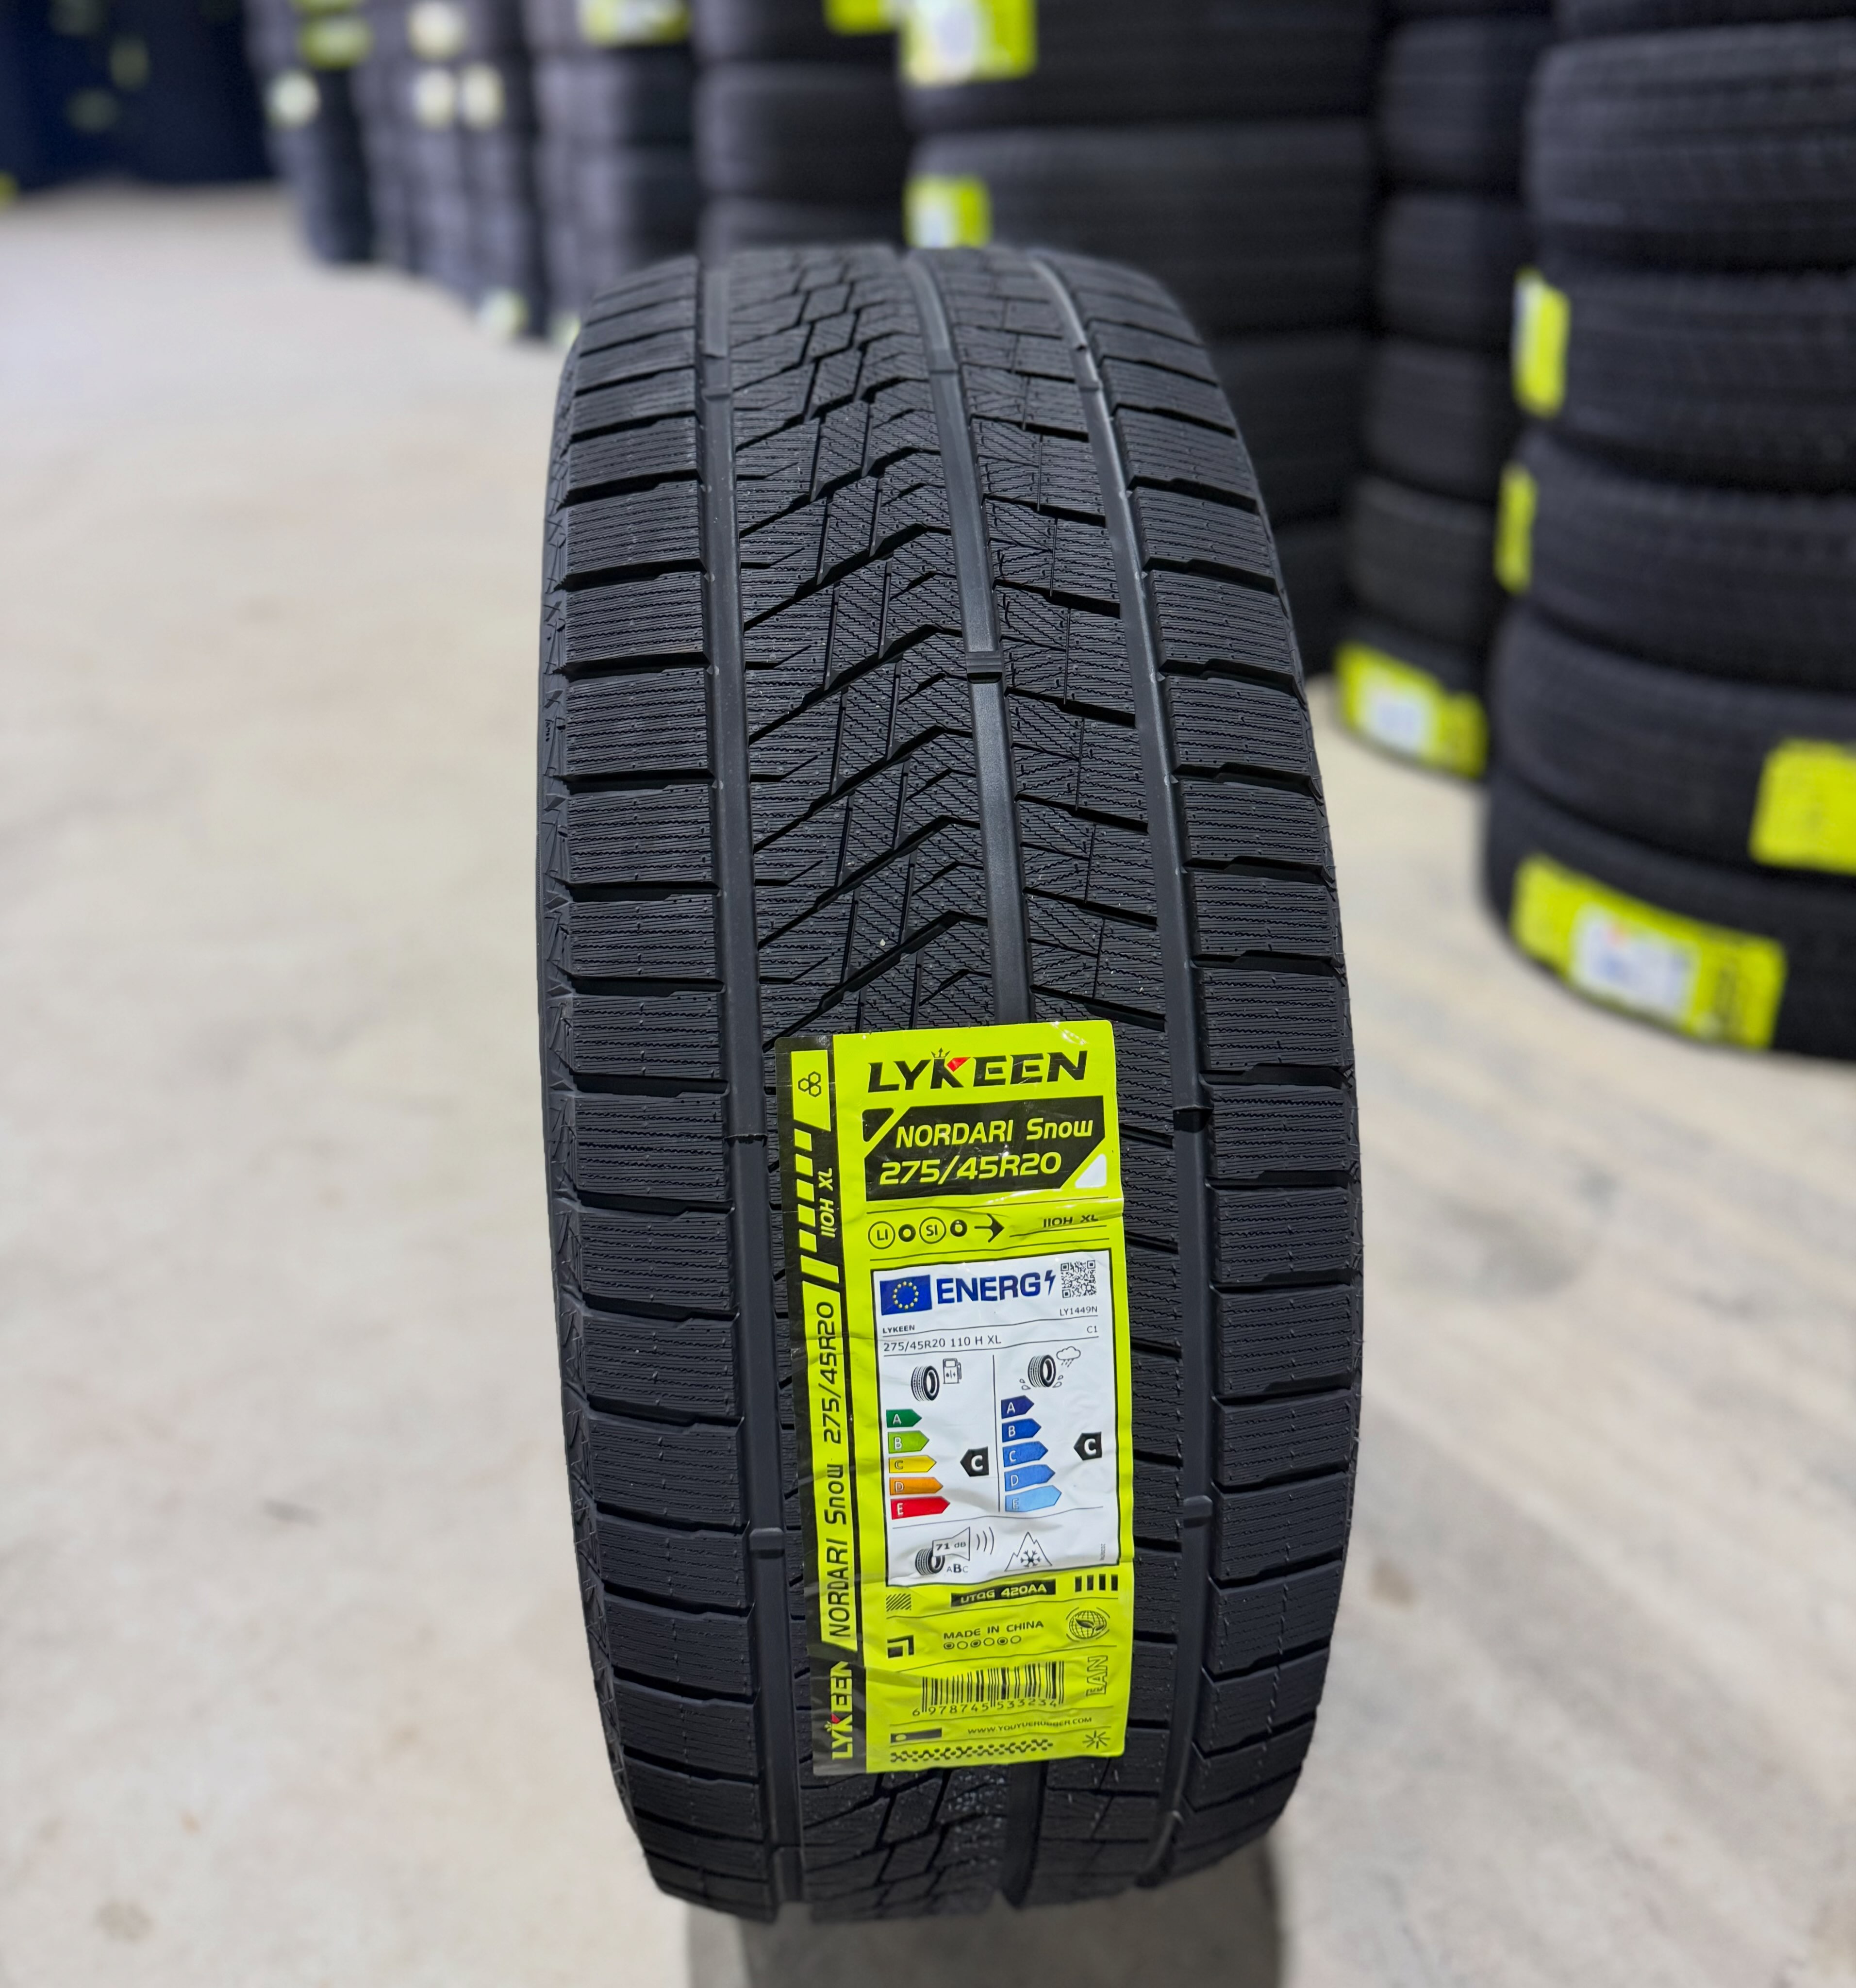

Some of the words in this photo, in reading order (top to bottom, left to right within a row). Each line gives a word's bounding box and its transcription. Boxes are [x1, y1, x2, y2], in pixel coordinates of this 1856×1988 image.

[867, 1050, 1088, 1093] LYKEEN
[895, 1119, 1013, 1149] NORDARI
[1027, 1117, 1094, 1141] Snow
[879, 1151, 1062, 1186] 275/45R20
[818, 1168, 833, 1191] XL
[819, 1197, 835, 1238] 110H
[1080, 1214, 1099, 1223] XL
[937, 1272, 1042, 1305] ENERG
[1060, 1306, 1098, 1316] LY1449N
[882, 1325, 915, 1334] LYKEEN
[883, 1338, 945, 1353] 275/45R20
[950, 1336, 971, 1347] 110
[975, 1336, 983, 1345] H
[987, 1334, 1001, 1344] XL
[816, 1301, 842, 1445] 275/45R20
[1006, 1402, 1015, 1415] A
[893, 1413, 902, 1425] A
[1008, 1425, 1016, 1438] B
[894, 1437, 903, 1449] B
[1084, 1438, 1096, 1455] C
[971, 1455, 983, 1471] C
[1009, 1450, 1016, 1462] C
[894, 1459, 904, 1470] C
[895, 1481, 904, 1492] D
[1010, 1474, 1019, 1487] D
[824, 1464, 847, 1525] Snow
[896, 1502, 904, 1516] E
[1012, 1498, 1019, 1510] E
[935, 1542, 950, 1551] 71
[826, 1537, 851, 1637] NORDARI
[1001, 1583, 1047, 1598] 420AA
[944, 1628, 981, 1640] MADE
[987, 1625, 1000, 1634] IN
[1006, 1620, 1044, 1633] CHINA
[1086, 1655, 1108, 1696] EAN
